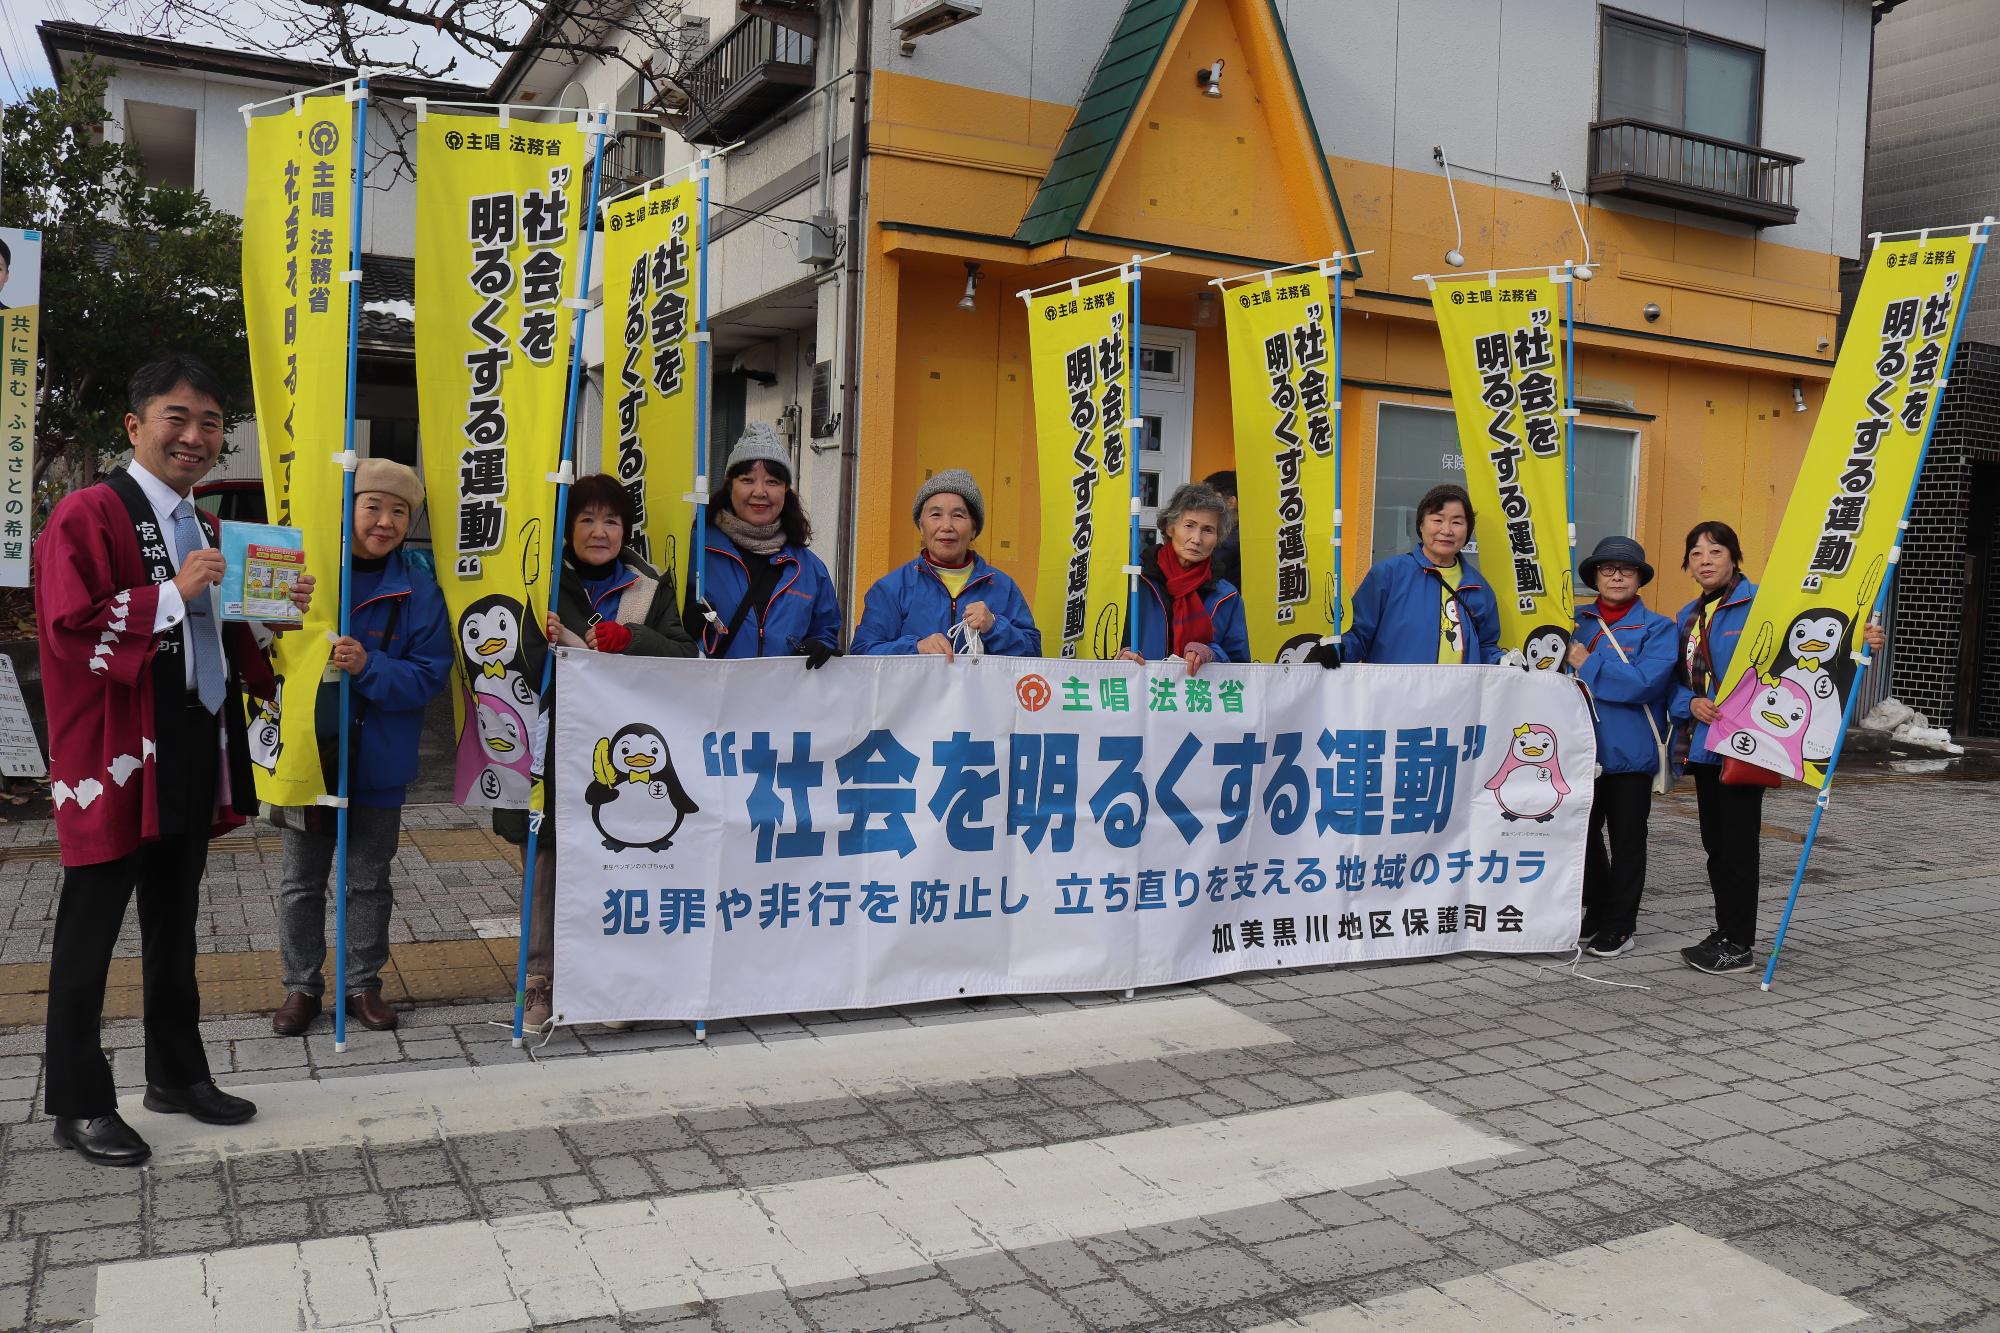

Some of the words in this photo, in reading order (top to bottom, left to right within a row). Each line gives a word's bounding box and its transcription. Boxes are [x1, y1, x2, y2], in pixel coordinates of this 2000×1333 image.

[466, 132, 500, 151] 主唱
[509, 134, 562, 157] 法務省
[311, 161, 335, 217] 主唱
[625, 206, 646, 228] 主唱
[648, 194, 681, 216] 法務省
[308, 228, 334, 313] 法務省
[1898, 252, 1919, 267] 主唱
[1922, 250, 1956, 265] 法務省
[1058, 300, 1078, 318] 主唱
[1083, 291, 1116, 311] 法務省
[1251, 290, 1272, 306] 主唱
[1276, 283, 1311, 301] 法務省
[1466, 290, 1493, 304] 主唱
[1498, 289, 1538, 302] 法務省
[3, 314, 31, 560] 共に育む、ふるさとの希望
[1061, 675, 1130, 712] 主唱
[1148, 677, 1245, 713] 法務省
[702, 723, 1487, 864] “社会を明るくする運動”
[601, 876, 1030, 936] 犯罪や非行を防止し
[1054, 849, 1547, 914] 立ち直りを支える地域のチカラ
[1212, 903, 1525, 954] 加美黒川地区保護司会
